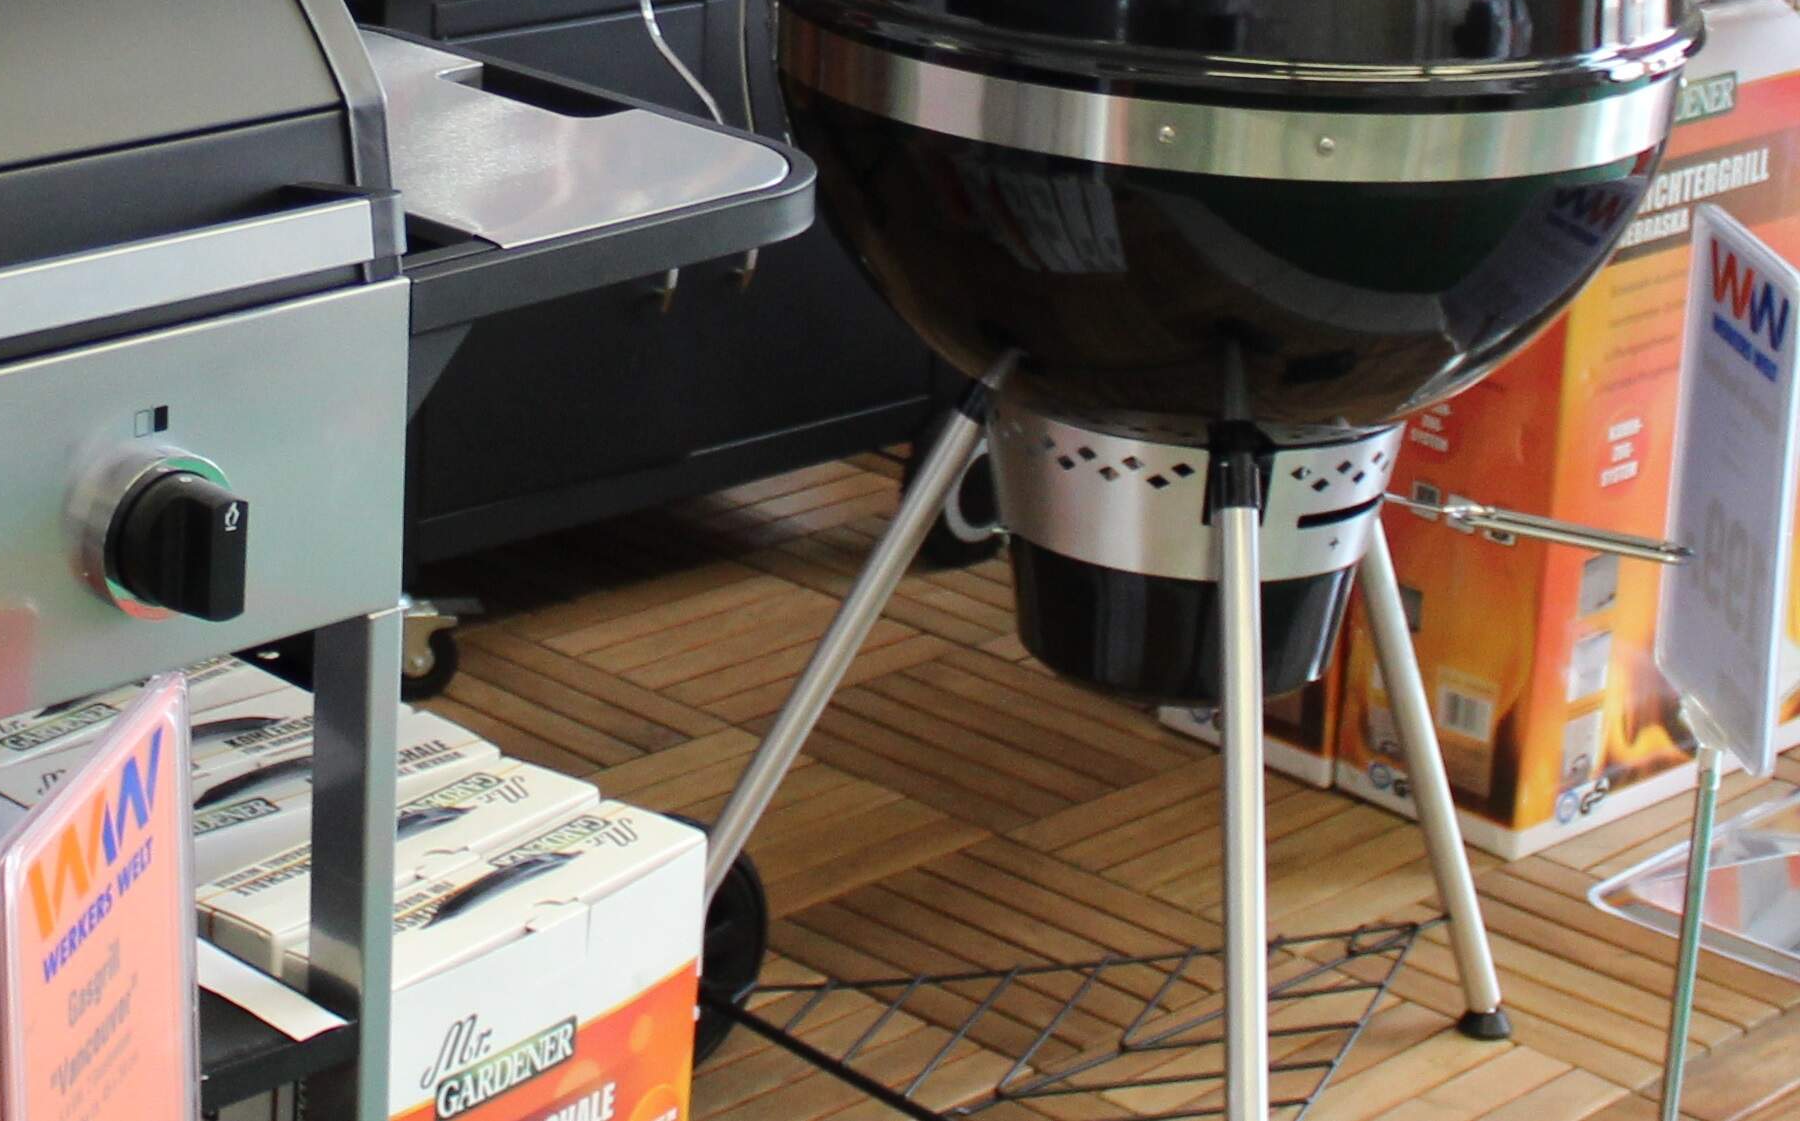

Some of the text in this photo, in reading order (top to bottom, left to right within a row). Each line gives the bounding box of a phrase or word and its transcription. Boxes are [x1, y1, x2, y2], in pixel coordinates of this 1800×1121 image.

[43, 882, 114, 984] WERKERS
[117, 836, 153, 898] WELT
[420, 1012, 493, 1090] Mr.
[436, 1022, 575, 1120] GARDENER
